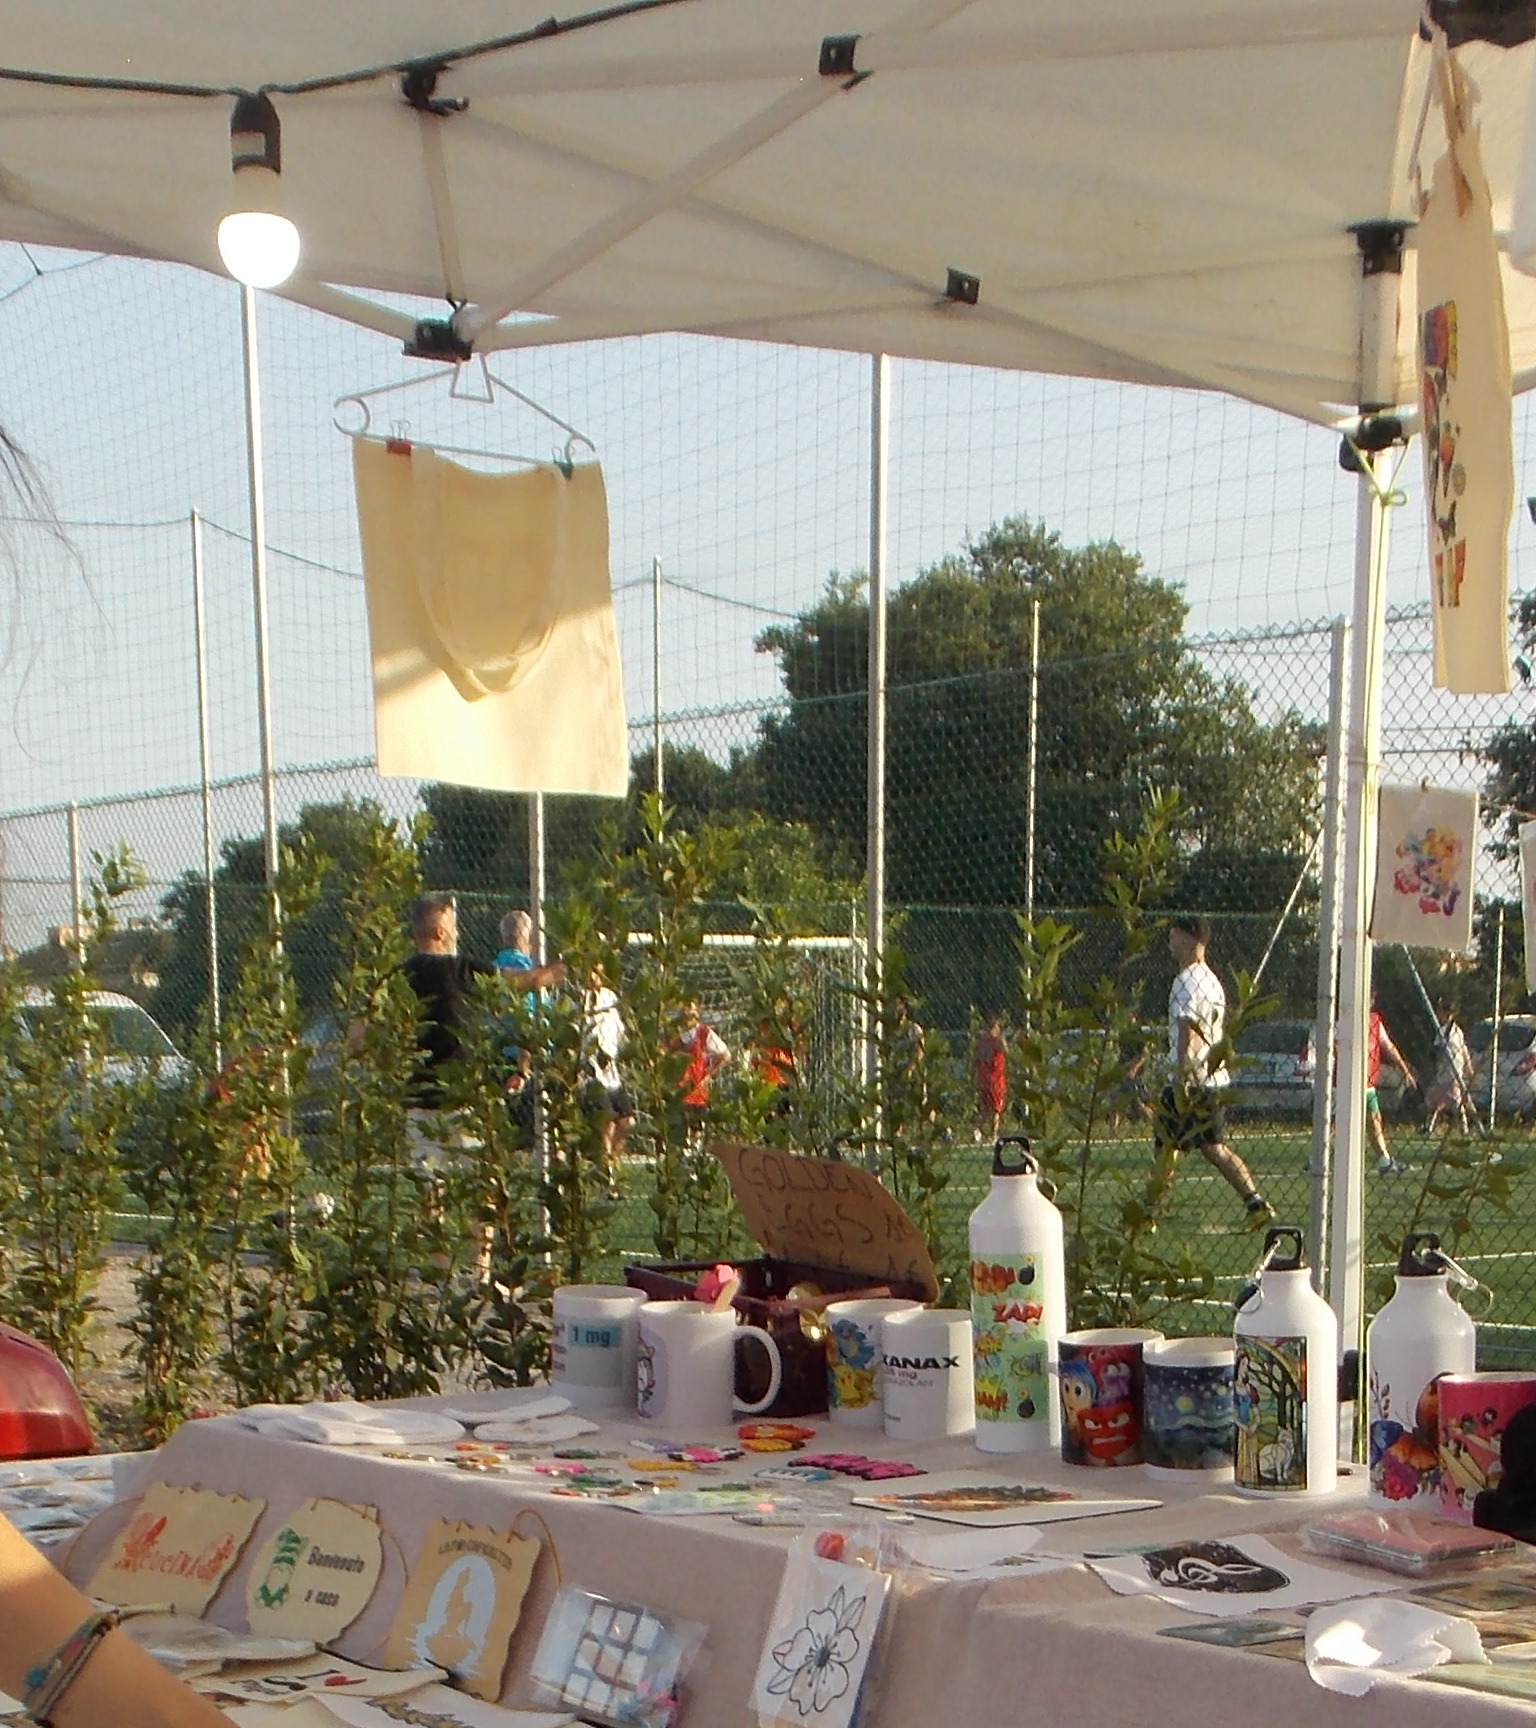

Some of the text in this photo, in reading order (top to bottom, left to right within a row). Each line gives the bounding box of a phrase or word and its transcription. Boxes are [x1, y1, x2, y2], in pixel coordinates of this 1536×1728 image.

[739, 1148, 872, 1199] GOLDEN
[992, 1303, 1044, 1327] ZAP!
[572, 1325, 611, 1348] 1 mg
